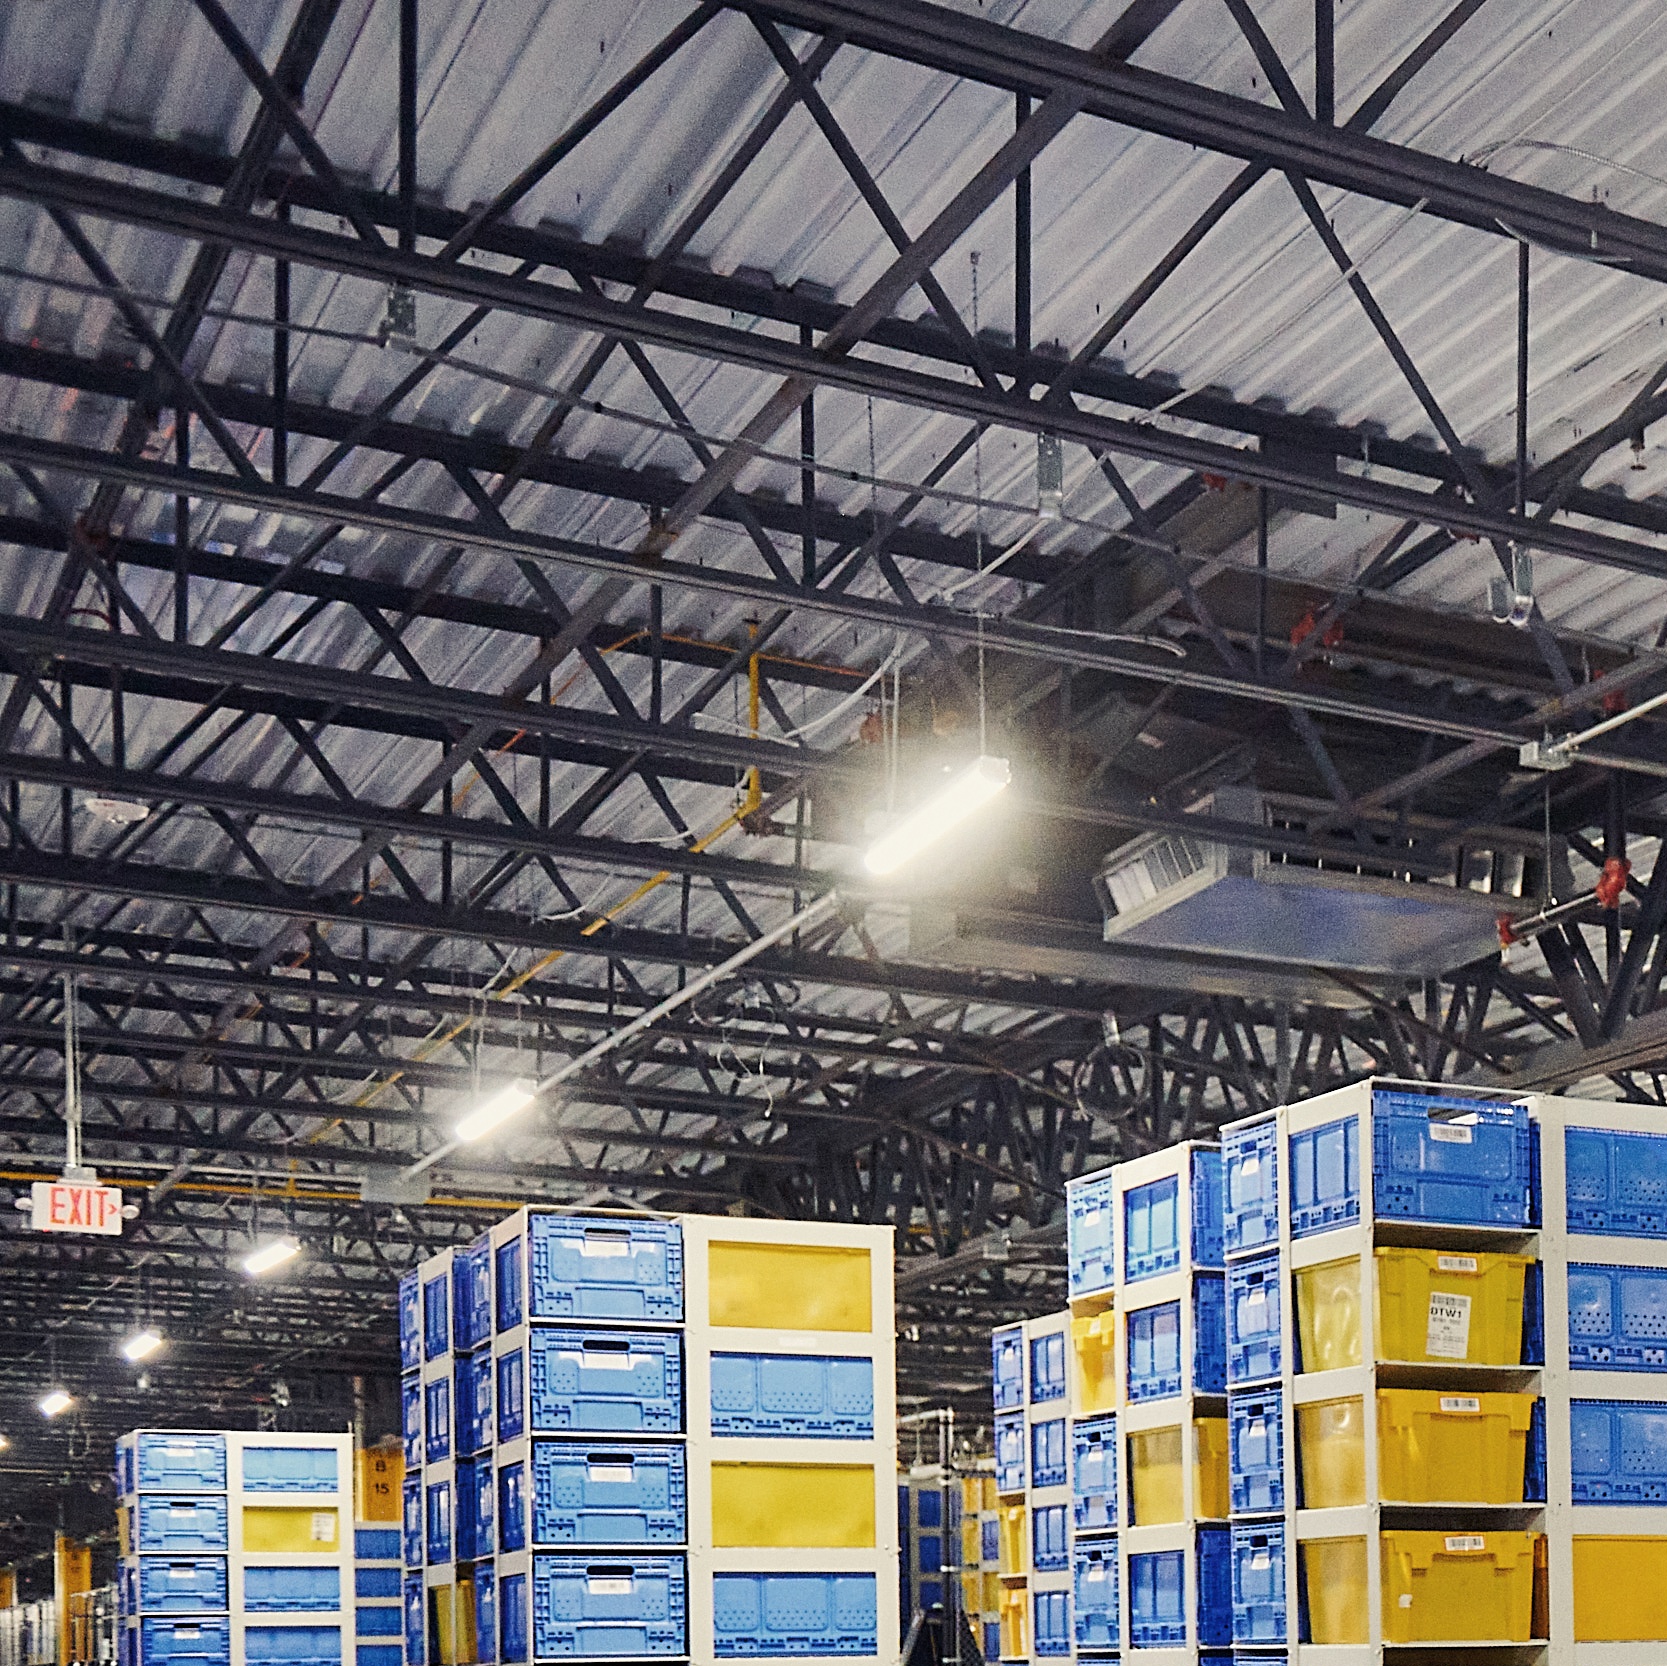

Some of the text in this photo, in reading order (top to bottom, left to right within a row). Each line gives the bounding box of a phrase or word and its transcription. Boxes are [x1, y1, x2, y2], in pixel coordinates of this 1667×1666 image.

[49, 1186, 109, 1227] EXIT
[1430, 1307, 1462, 1318] DTW1
[375, 1482, 390, 1494] 15
